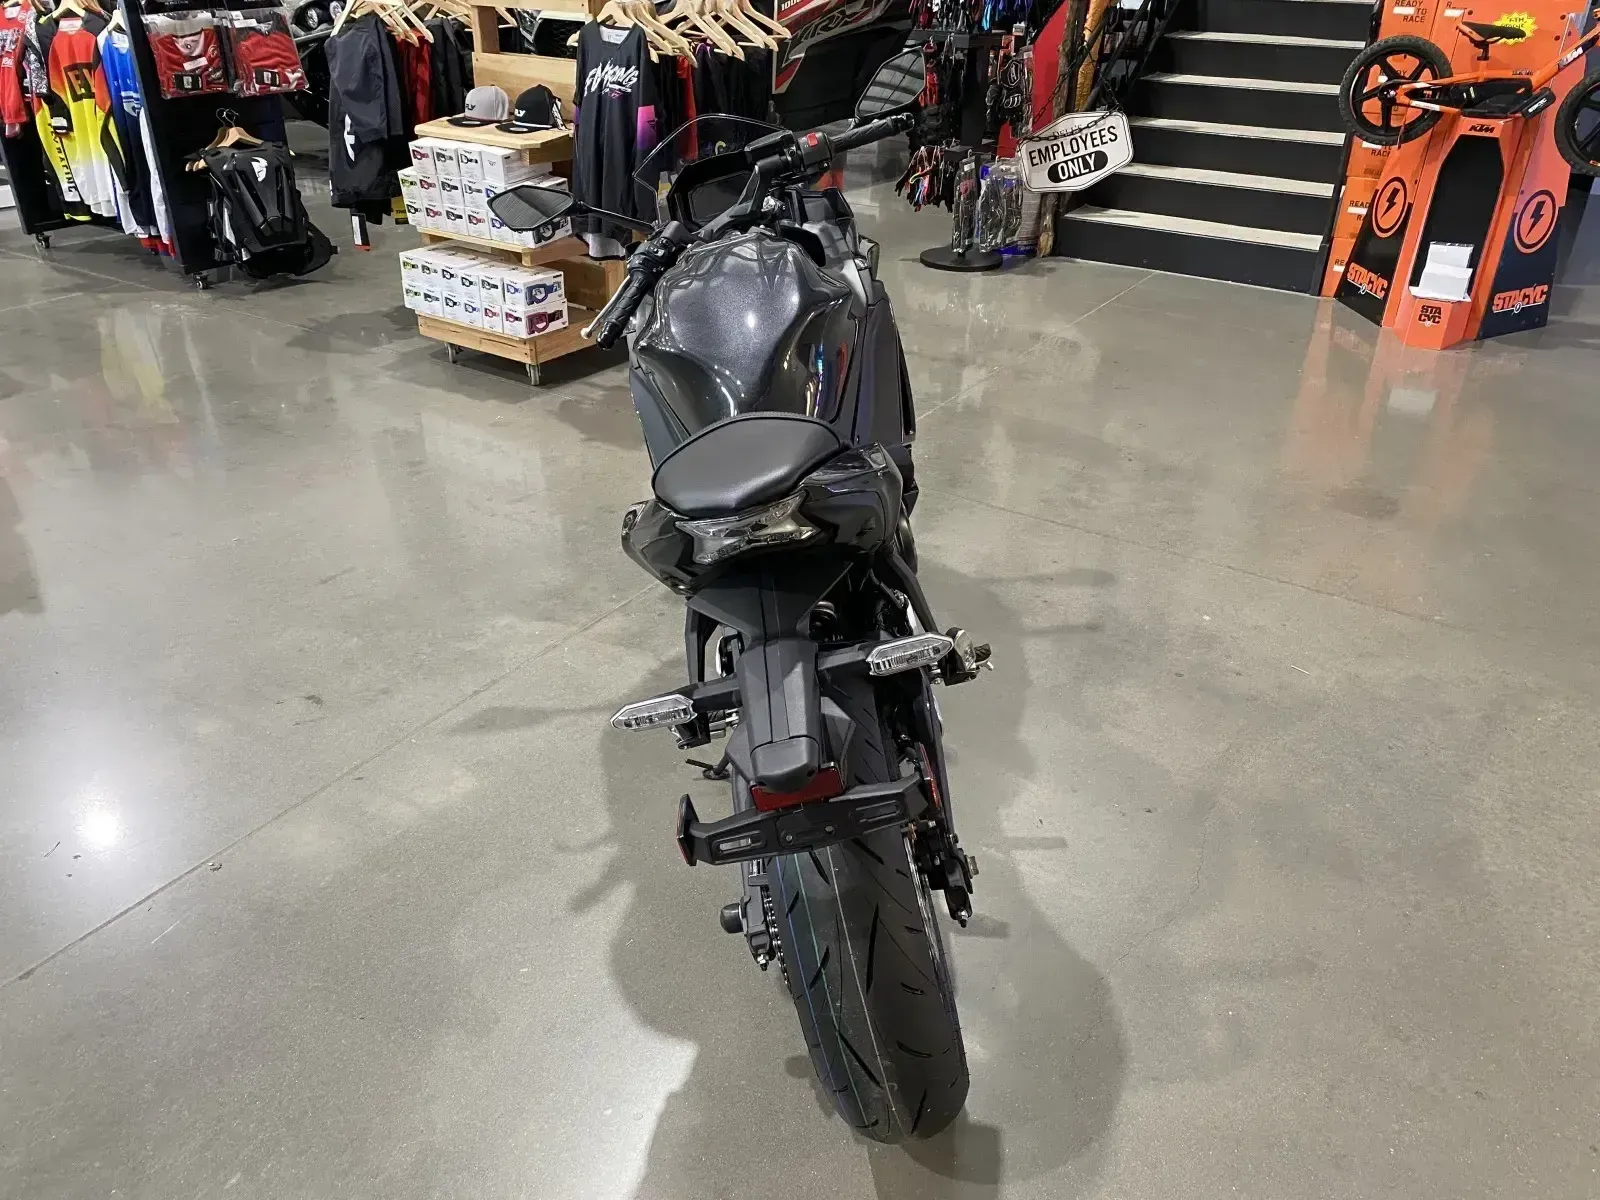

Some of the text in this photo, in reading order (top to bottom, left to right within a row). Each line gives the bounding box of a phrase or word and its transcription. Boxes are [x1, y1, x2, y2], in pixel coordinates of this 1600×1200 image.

[1402, 15, 1426, 23] RACE
[1417, 8, 1427, 16] TO
[1468, 123, 1496, 134] KTM
[1028, 125, 1118, 167] EMPLOYEES
[1057, 153, 1096, 180] ONLY
[1347, 262, 1388, 299] STACYC
[1492, 284, 1548, 312] STACYC
[1420, 304, 1442, 315] STA
